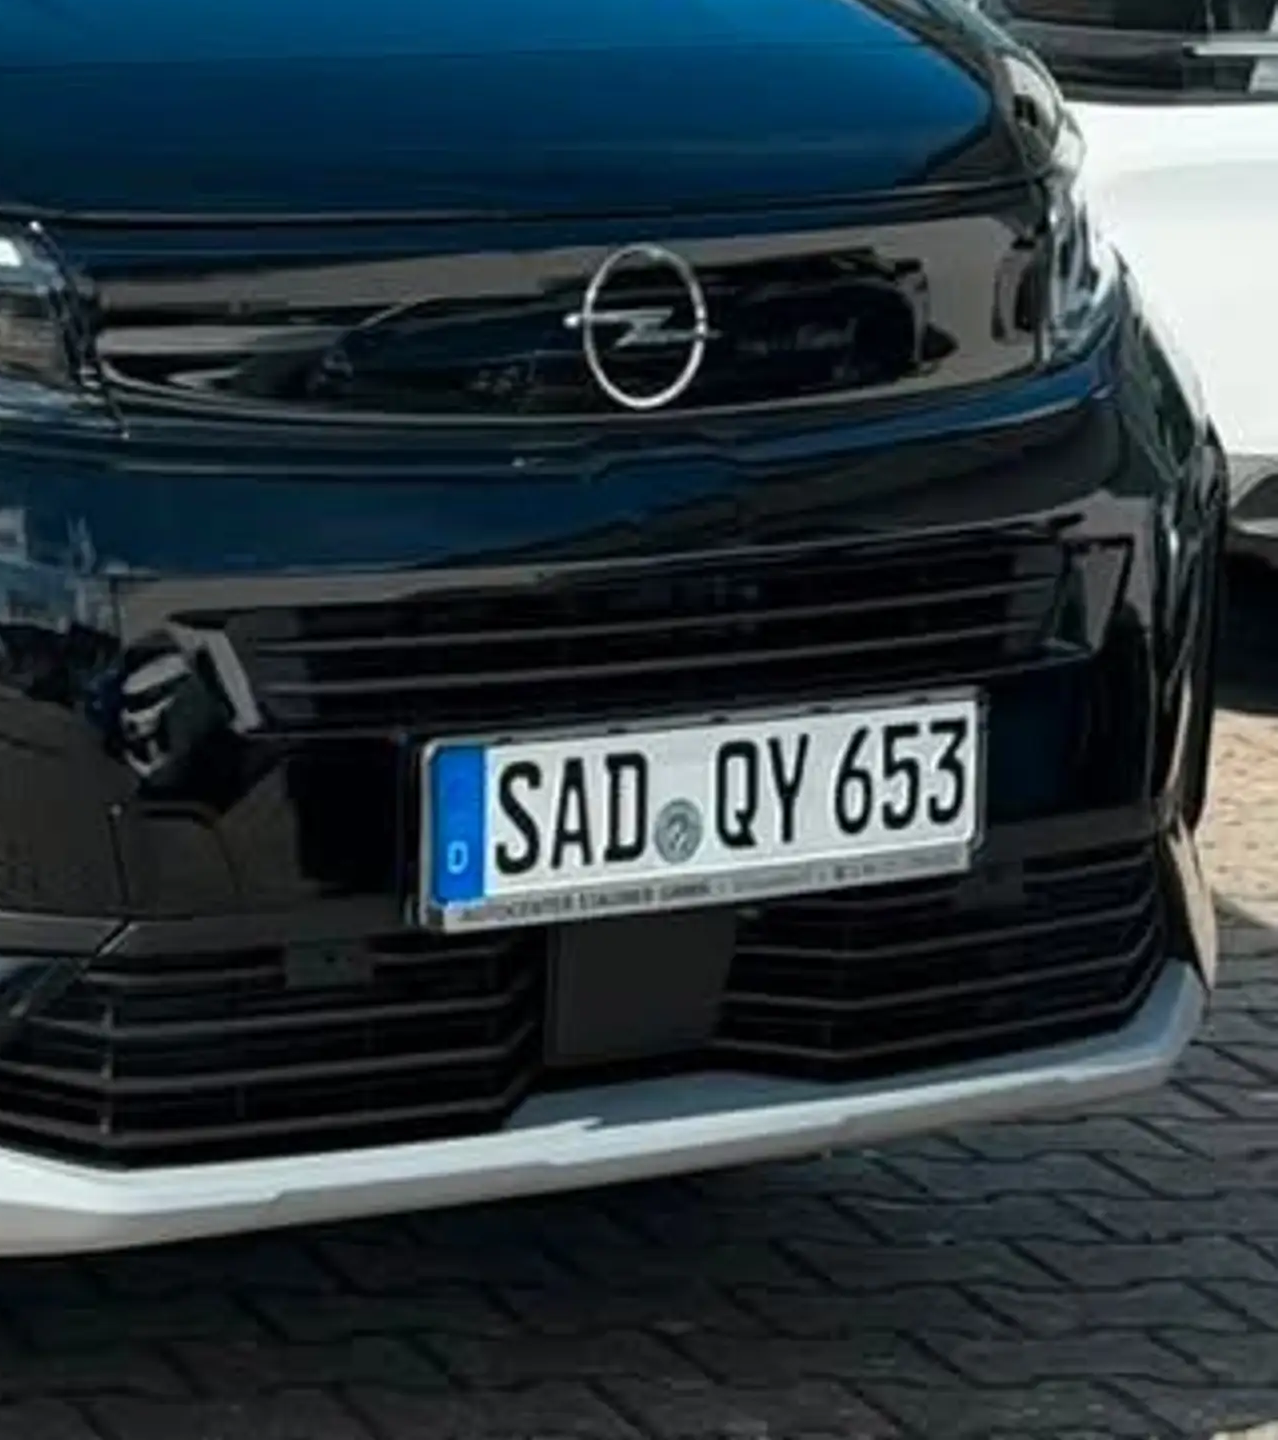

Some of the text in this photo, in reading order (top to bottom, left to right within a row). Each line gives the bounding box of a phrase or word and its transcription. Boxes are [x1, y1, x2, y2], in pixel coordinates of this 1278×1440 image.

[494, 717, 969, 876] SAD QY 653
[447, 841, 469, 875] D
